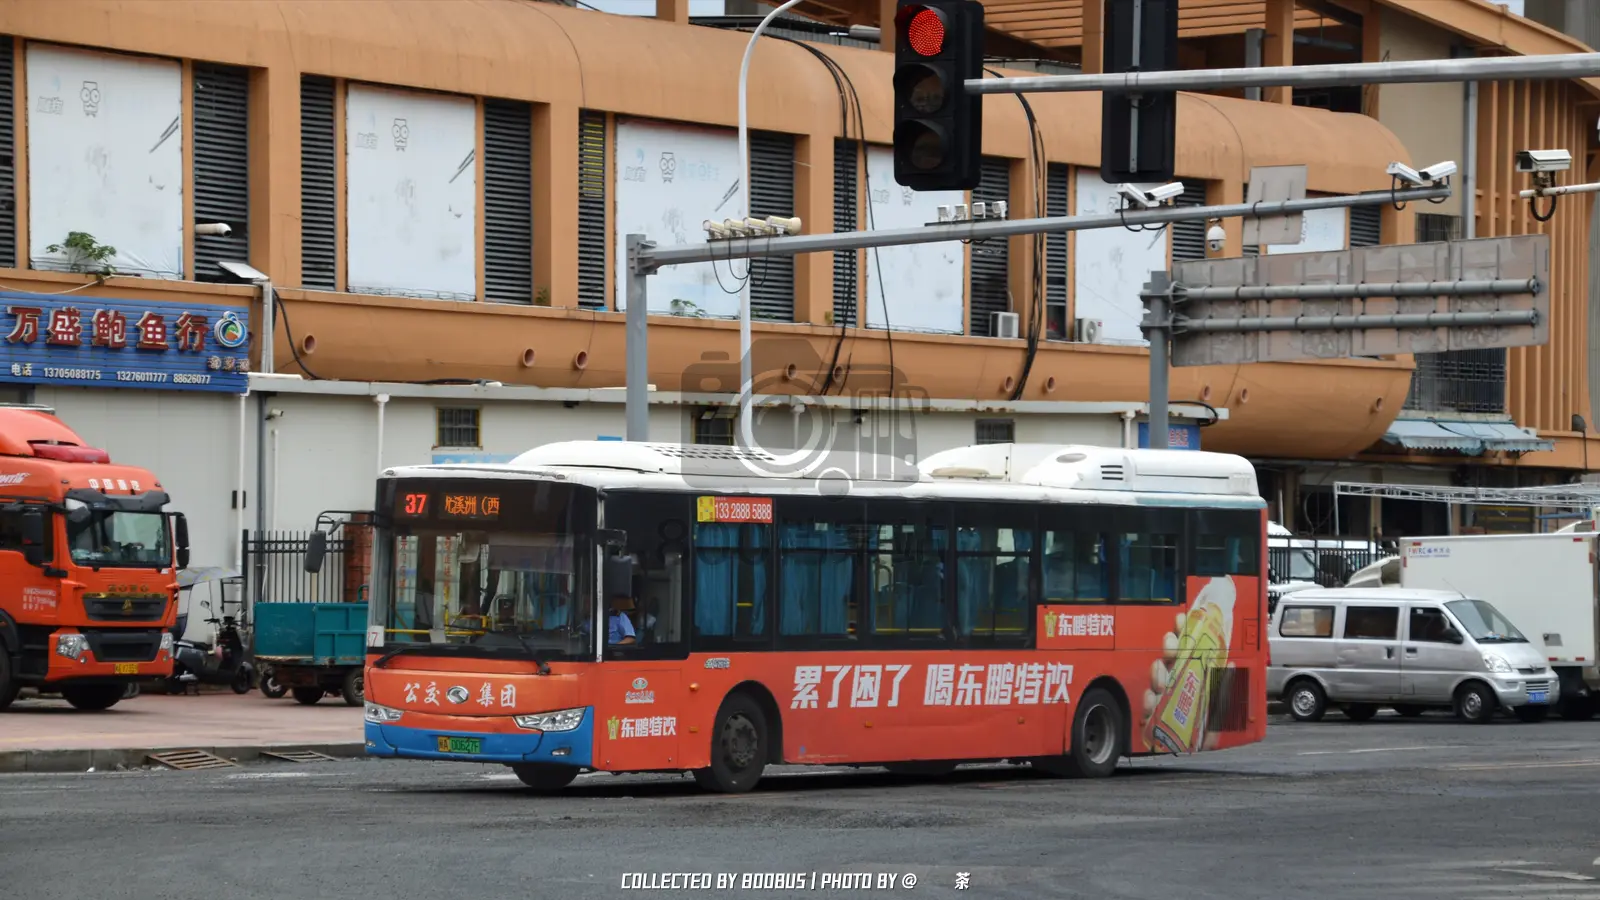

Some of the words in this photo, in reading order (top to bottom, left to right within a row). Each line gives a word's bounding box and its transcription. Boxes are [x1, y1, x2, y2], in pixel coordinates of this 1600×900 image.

[4, 305, 210, 351] 万盛鲍鱼行
[11, 362, 33, 377] 电话
[43, 366, 102, 380] 13705088175
[116, 370, 168, 383] 13276011777
[173, 373, 211, 384] 88626077
[88, 478, 141, 491] 中国
[405, 494, 427, 514] 37
[715, 502, 730, 519] 133
[730, 503, 751, 519] 2888
[752, 503, 772, 520] 5888
[1058, 613, 1115, 636] 东鹏特饮
[403, 681, 441, 707] 公交
[475, 681, 518, 708] 集团
[790, 664, 912, 709] 累了困了
[923, 661, 1074, 706] 喝东鹏特饮
[620, 715, 677, 738] 东鹏特饮
